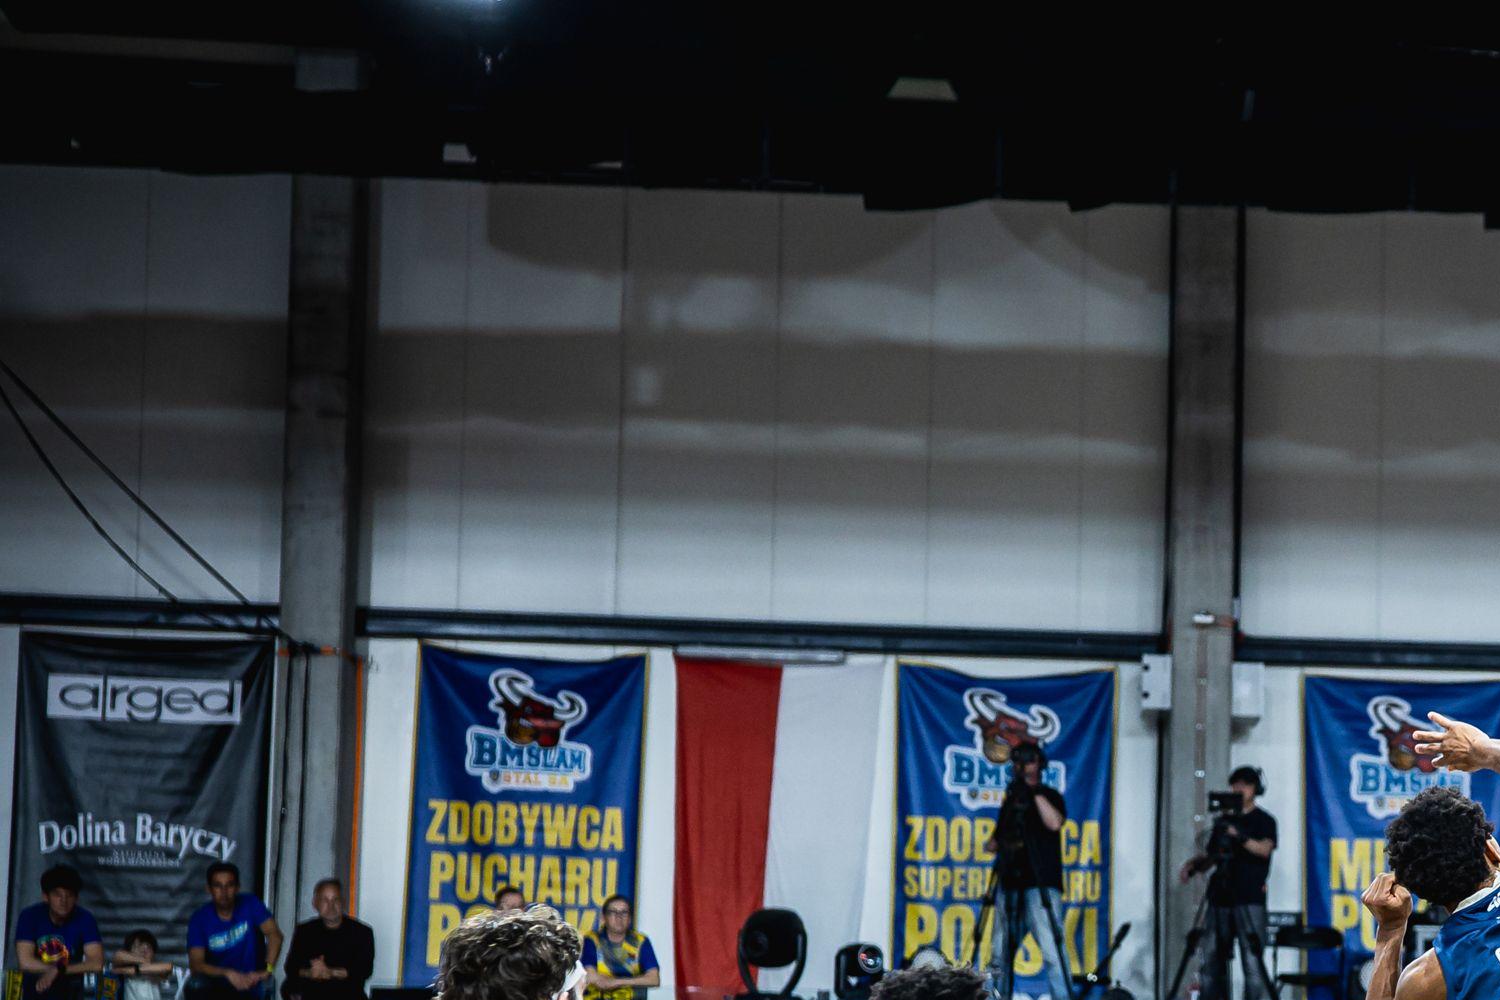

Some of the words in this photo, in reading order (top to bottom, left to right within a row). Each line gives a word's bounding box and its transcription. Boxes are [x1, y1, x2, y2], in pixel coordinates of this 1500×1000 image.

[38, 812, 127, 853] Dolina
[134, 813, 238, 862] Baryczy
[425, 799, 625, 851] ZDOBYWCA
[903, 816, 1101, 866] ZDOBCA
[427, 851, 619, 906] PUCHARU
